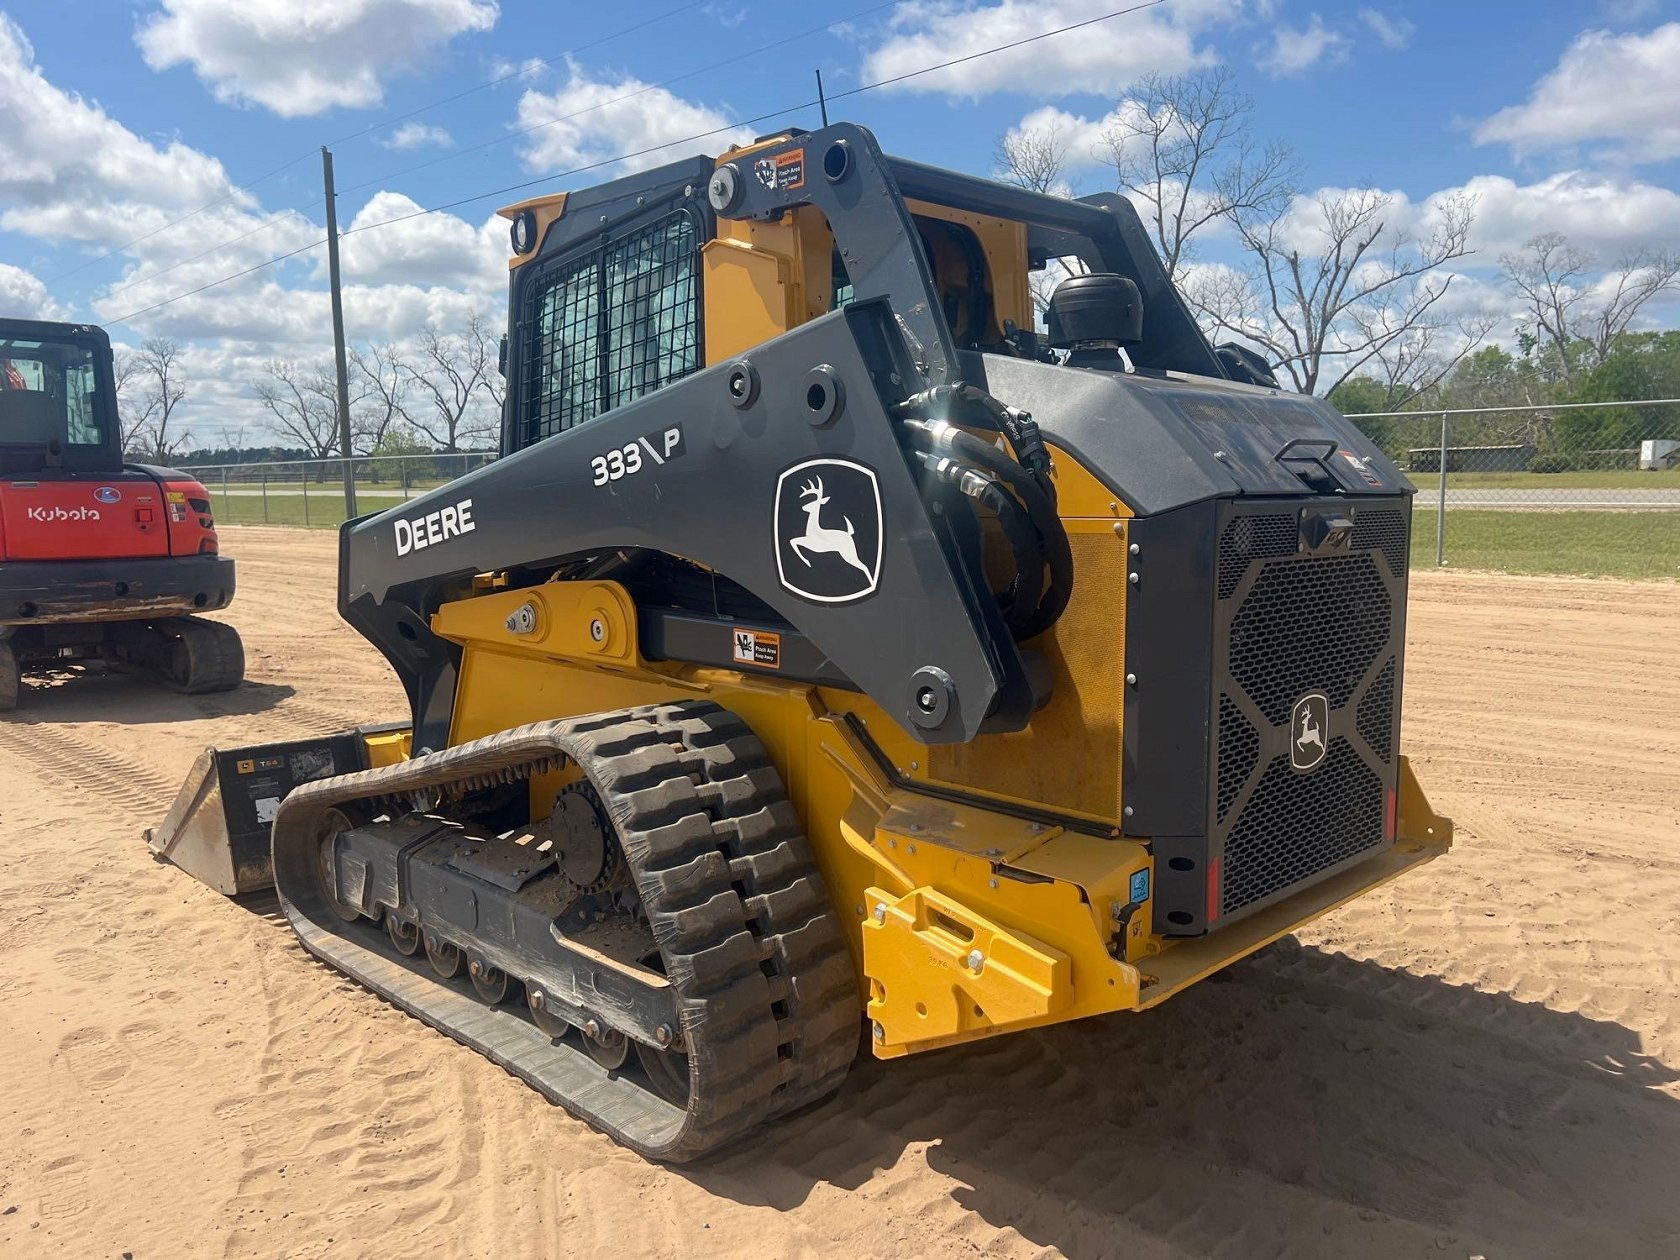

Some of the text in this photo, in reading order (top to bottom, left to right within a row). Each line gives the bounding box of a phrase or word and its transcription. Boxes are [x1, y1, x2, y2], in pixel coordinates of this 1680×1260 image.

[28, 506, 100, 521] Kubota
[394, 499, 476, 556] DEERE
[767, 647, 777, 655] Area
